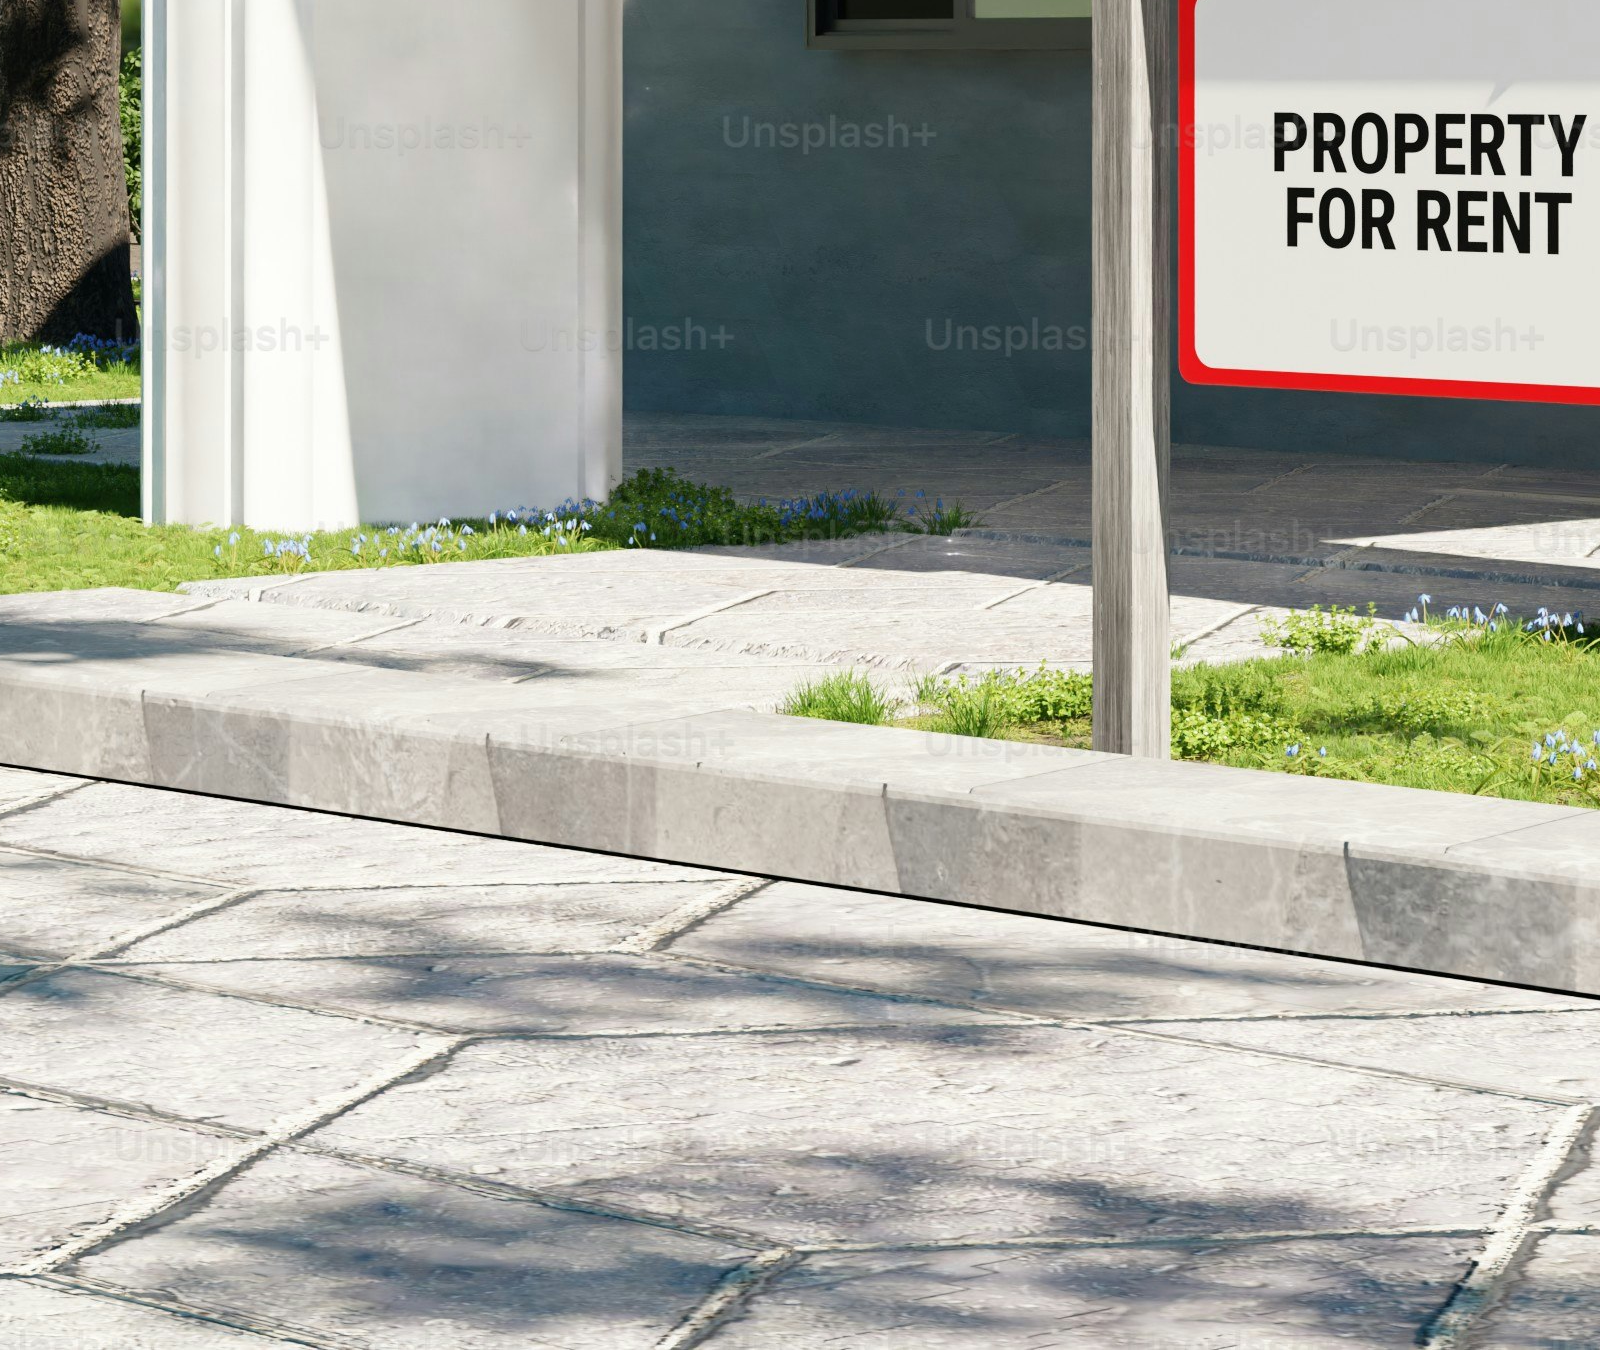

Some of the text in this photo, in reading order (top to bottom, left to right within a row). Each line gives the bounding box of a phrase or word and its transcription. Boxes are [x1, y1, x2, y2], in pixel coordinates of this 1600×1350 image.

[1275, 113, 1587, 176] PROPERTY
[1288, 188, 1572, 254] FOR RENT
